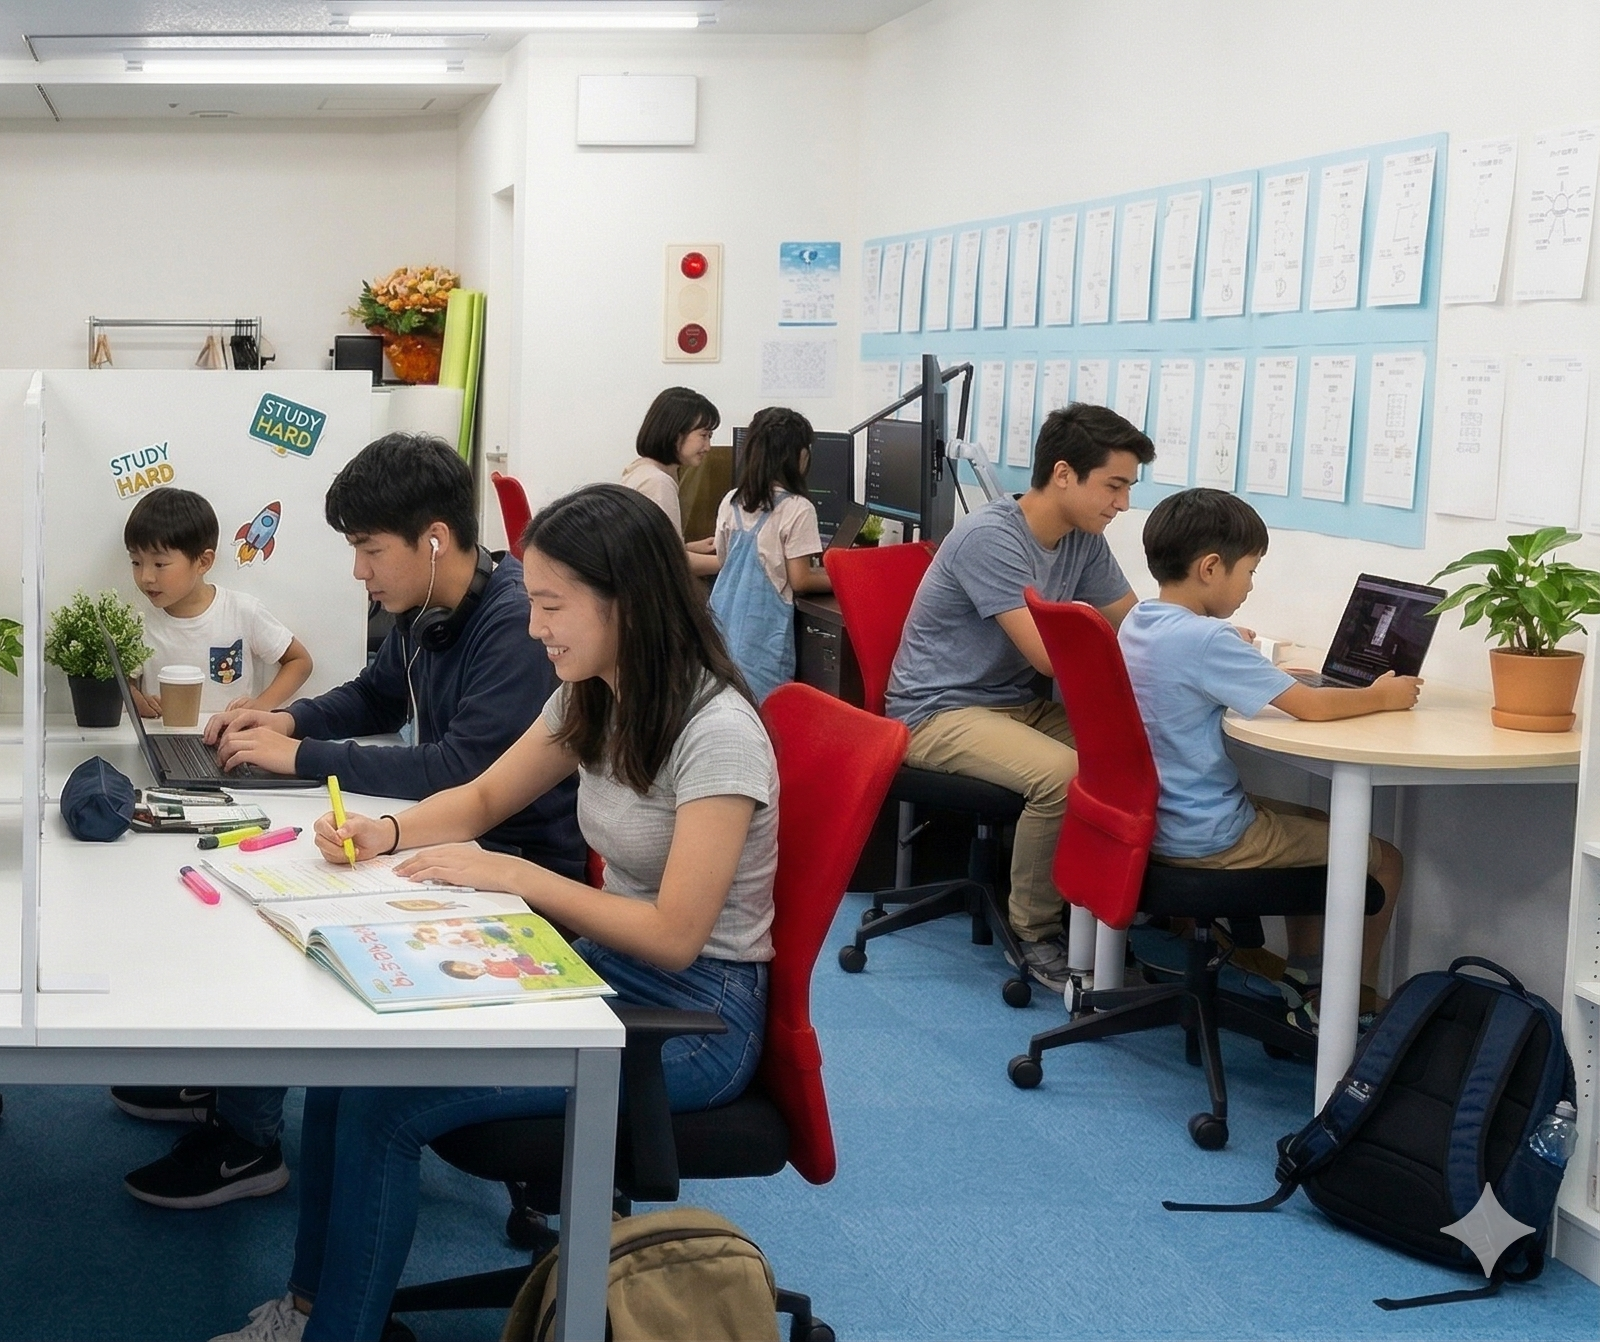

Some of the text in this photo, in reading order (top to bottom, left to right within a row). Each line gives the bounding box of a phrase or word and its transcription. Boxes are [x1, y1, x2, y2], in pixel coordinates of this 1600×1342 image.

[256, 415, 312, 449] HARD
[263, 399, 321, 432] STUDY
[110, 442, 169, 476] STUDY
[116, 463, 175, 497] HARD
